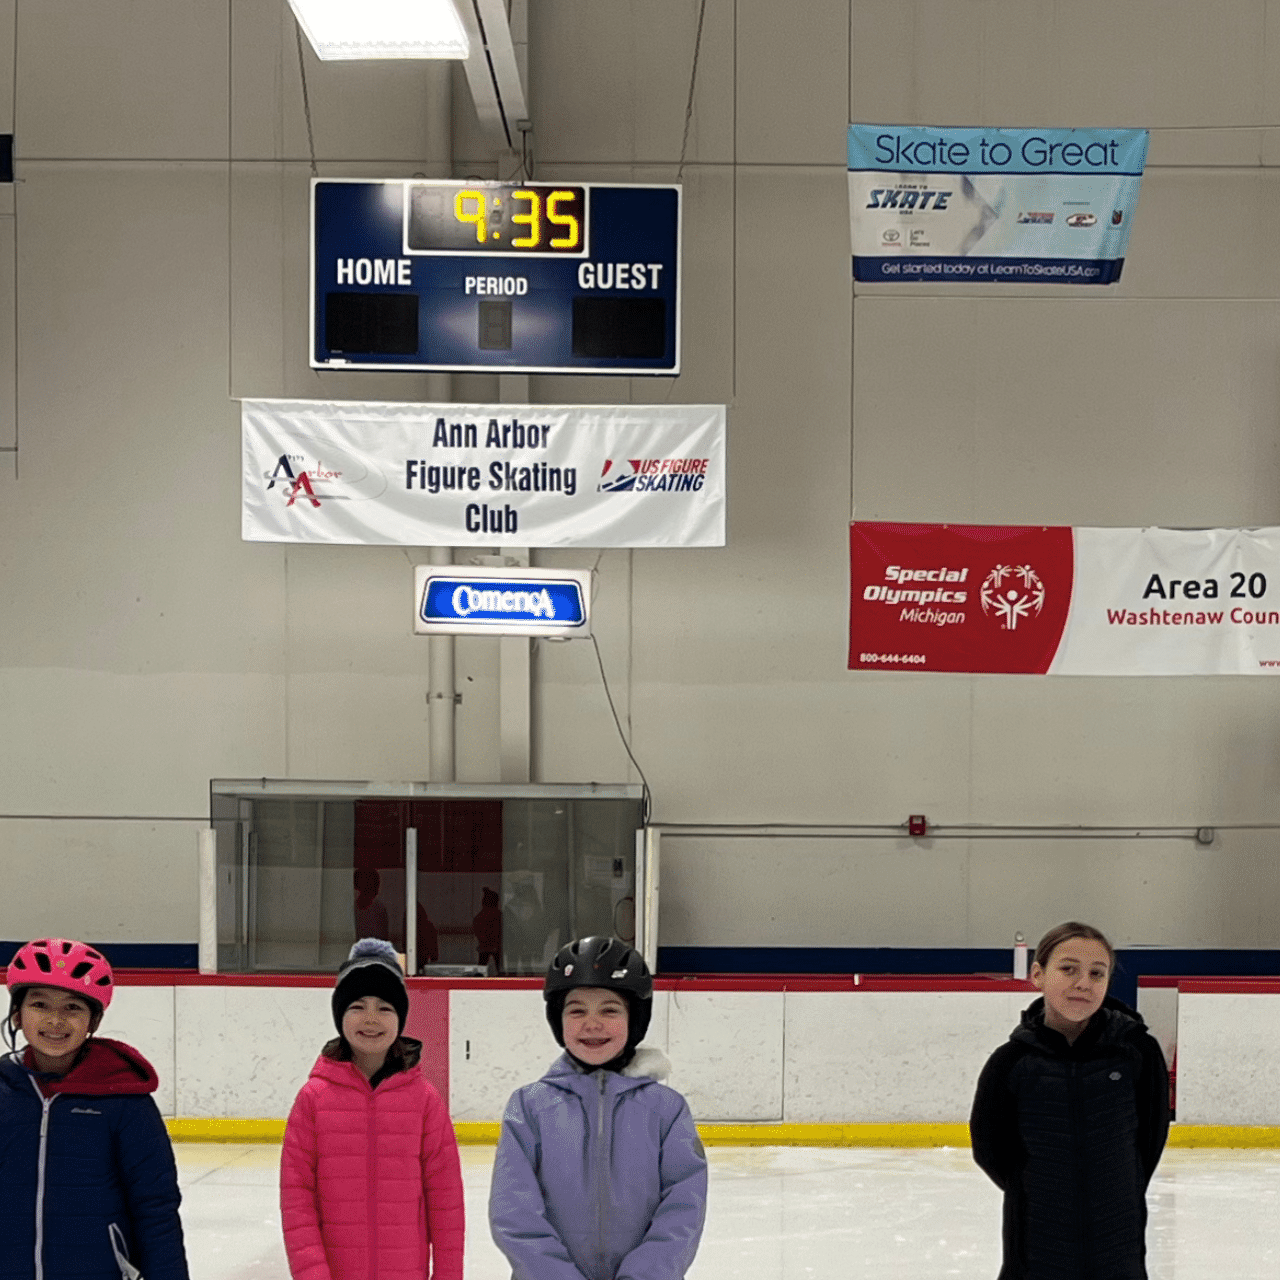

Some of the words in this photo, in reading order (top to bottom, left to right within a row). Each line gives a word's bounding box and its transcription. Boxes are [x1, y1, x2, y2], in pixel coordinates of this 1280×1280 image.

[875, 134, 970, 166] Skate
[979, 138, 1012, 166] to
[1021, 137, 1119, 167] Great
[866, 189, 953, 210] SKATE
[453, 190, 580, 249] 9:35
[337, 258, 412, 286] HOME
[577, 262, 663, 290] GUEST
[881, 262, 901, 275] Get
[902, 263, 943, 274] started
[943, 263, 976, 275] today
[976, 263, 990, 275] at
[465, 276, 528, 296] PERIOD
[432, 417, 478, 449] Ann
[485, 418, 551, 449] Arbor
[406, 459, 481, 494] Figure
[488, 460, 577, 496] Skating
[641, 460, 661, 475] US
[660, 459, 709, 475] FIGURE
[635, 474, 705, 492] SKATING
[465, 503, 518, 534] Club
[884, 565, 969, 585] Special
[1142, 573, 1219, 600] Area
[1229, 571, 1267, 599] 20
[863, 585, 968, 606] Olympics
[899, 607, 966, 627] Michigan
[1106, 607, 1224, 626] Washtenaw
